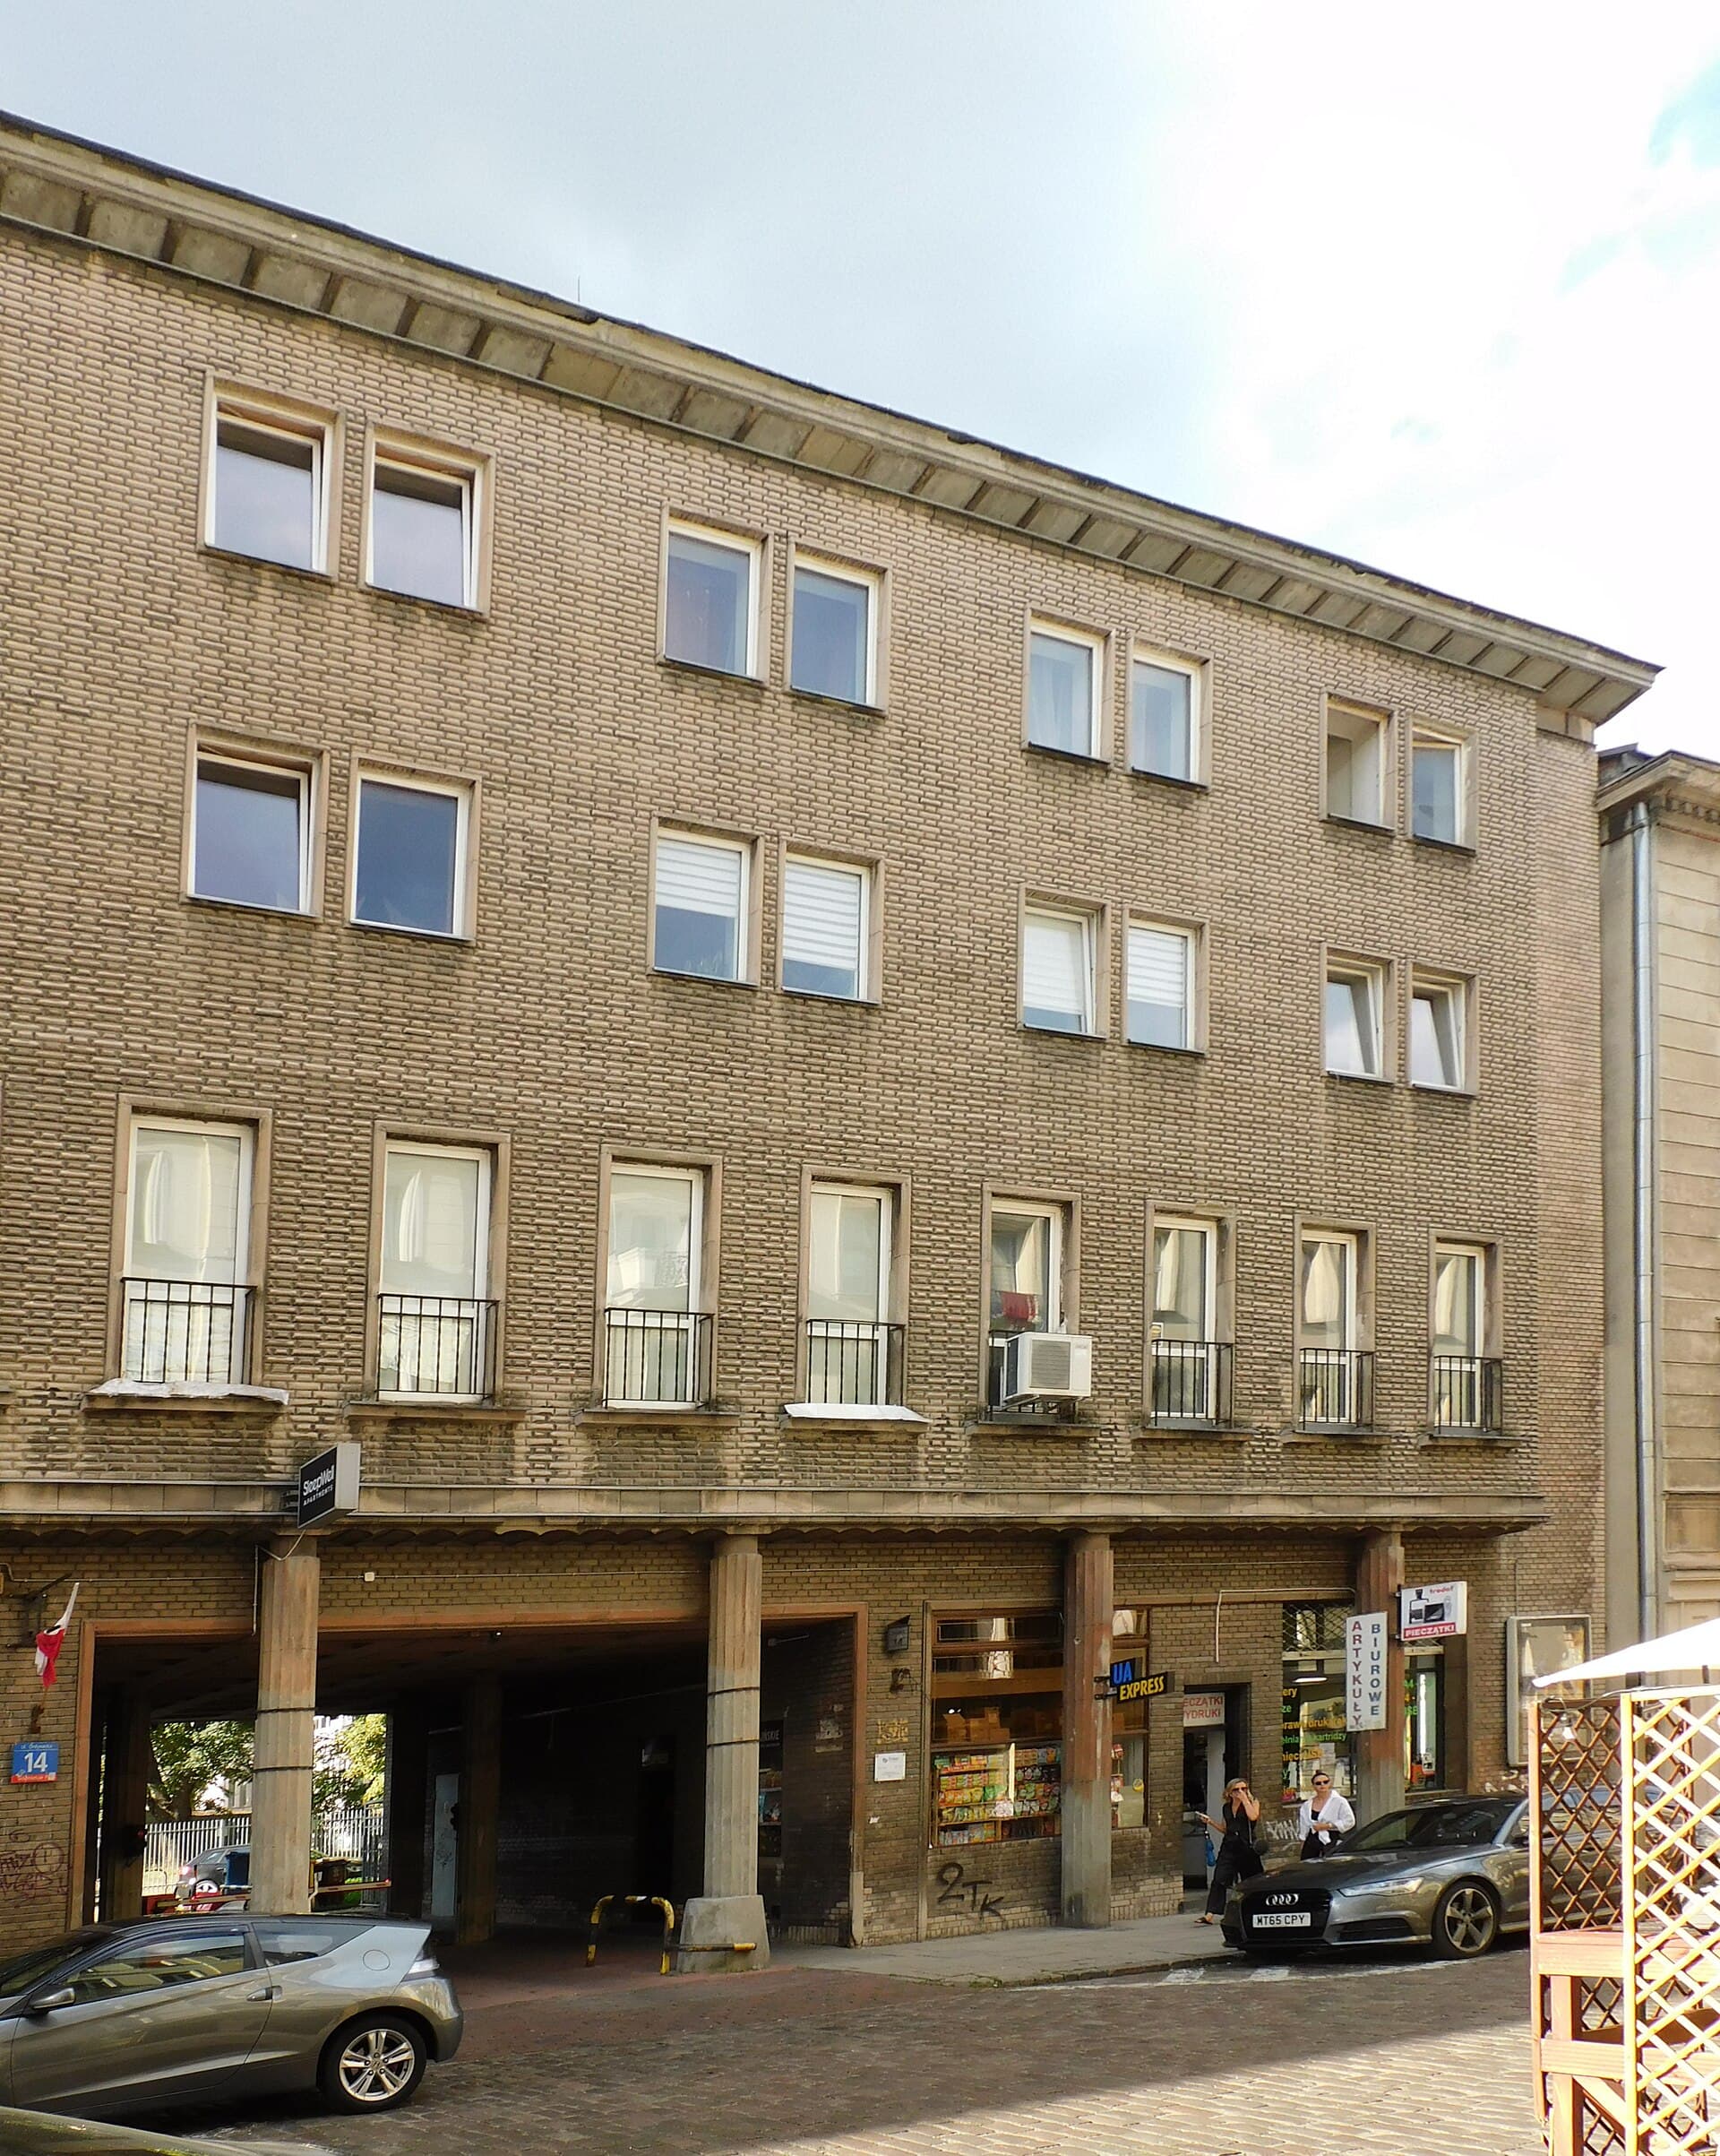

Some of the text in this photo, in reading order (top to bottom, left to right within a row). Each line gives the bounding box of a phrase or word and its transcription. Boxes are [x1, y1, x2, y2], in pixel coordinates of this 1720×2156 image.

[1405, 1625, 1455, 1638] PIECZĄTKI
[1114, 1661, 1133, 1684] UA
[1352, 1621, 1363, 1726] ARTYKUŁY
[1369, 1624, 1381, 1715] BIUROWE
[1120, 1676, 1165, 1701] EXPRESS
[24, 1752, 48, 1772] 14
[1285, 1915, 1305, 1925] CPY
